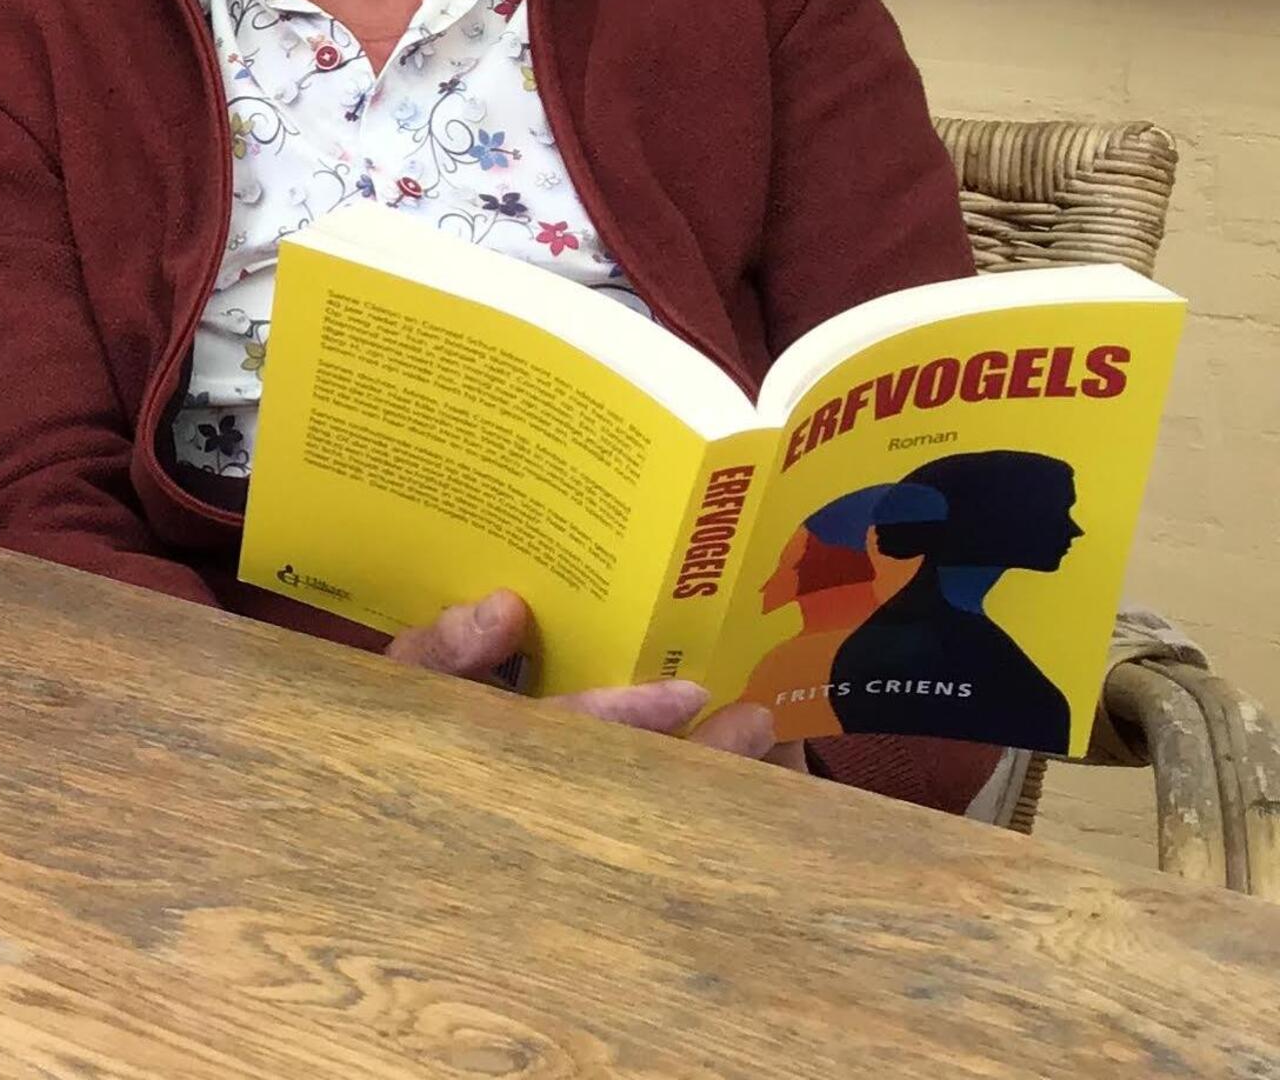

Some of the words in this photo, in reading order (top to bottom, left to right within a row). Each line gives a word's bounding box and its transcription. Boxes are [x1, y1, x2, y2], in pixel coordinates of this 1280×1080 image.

[780, 345, 1131, 474] ERFVOGELS
[887, 430, 958, 451] Roman
[672, 465, 756, 600] ERFVOGELS
[660, 650, 683, 678] FRIT
[775, 682, 851, 705] FRITS
[865, 679, 973, 698] CRIENS
